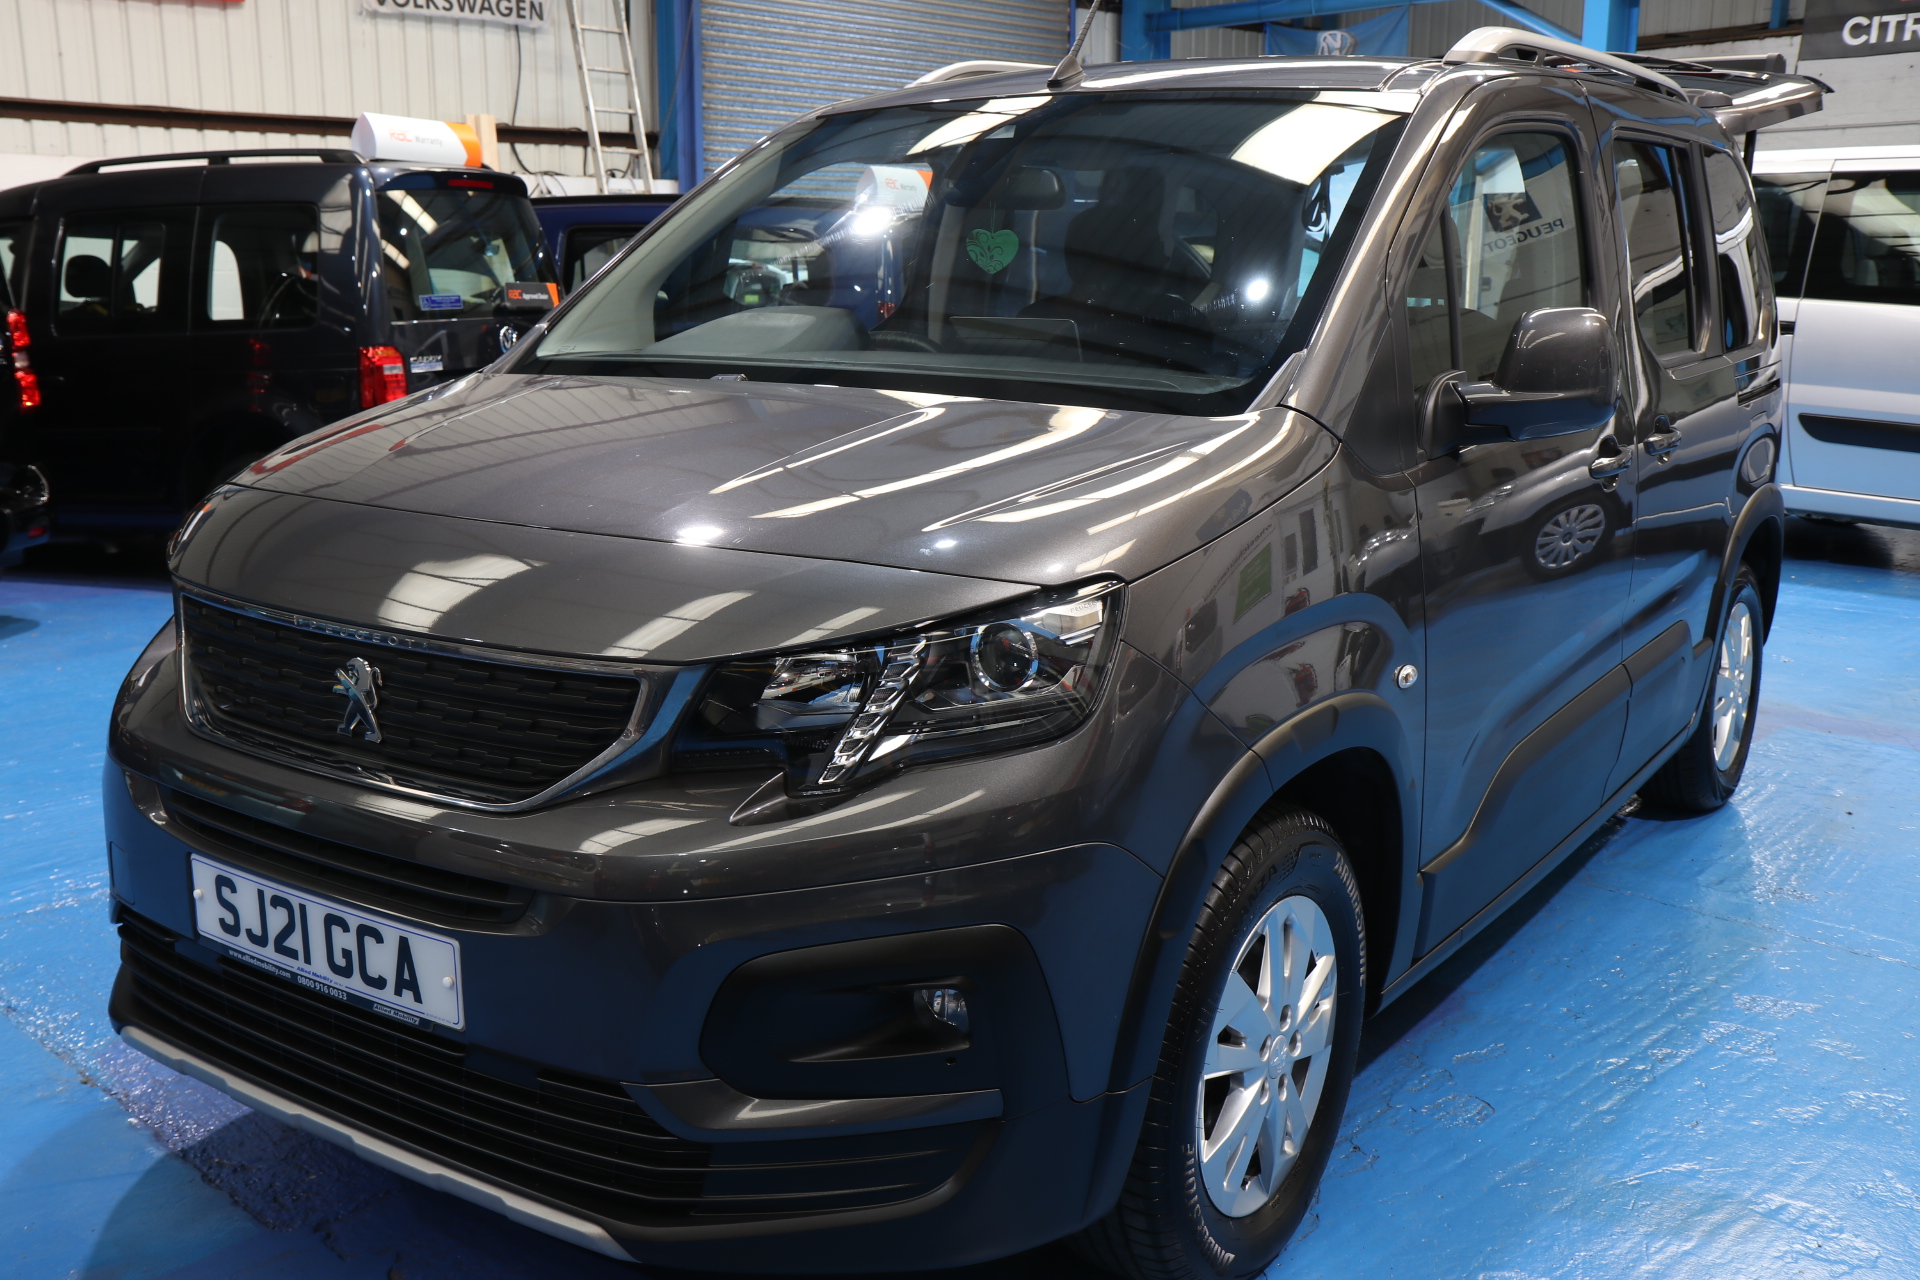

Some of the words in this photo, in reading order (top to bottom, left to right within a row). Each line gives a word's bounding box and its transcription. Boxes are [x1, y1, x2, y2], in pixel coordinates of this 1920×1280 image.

[375, 0, 545, 21] KSWAGEN
[309, 620, 415, 649] PEUGEOT
[1332, 850, 1367, 987] BRIDGESTONE
[214, 874, 312, 966] SJ21
[323, 912, 423, 1005] GCA
[228, 949, 292, 979] www.alliedmobility.com
[296, 966, 312, 976] Allied
[312, 971, 334, 984] Mobility
[297, 975, 315, 988] 0800
[315, 982, 329, 994] 916
[329, 987, 347, 1001] 0033
[374, 1004, 392, 1015] Allied
[393, 1011, 418, 1024] Mobility
